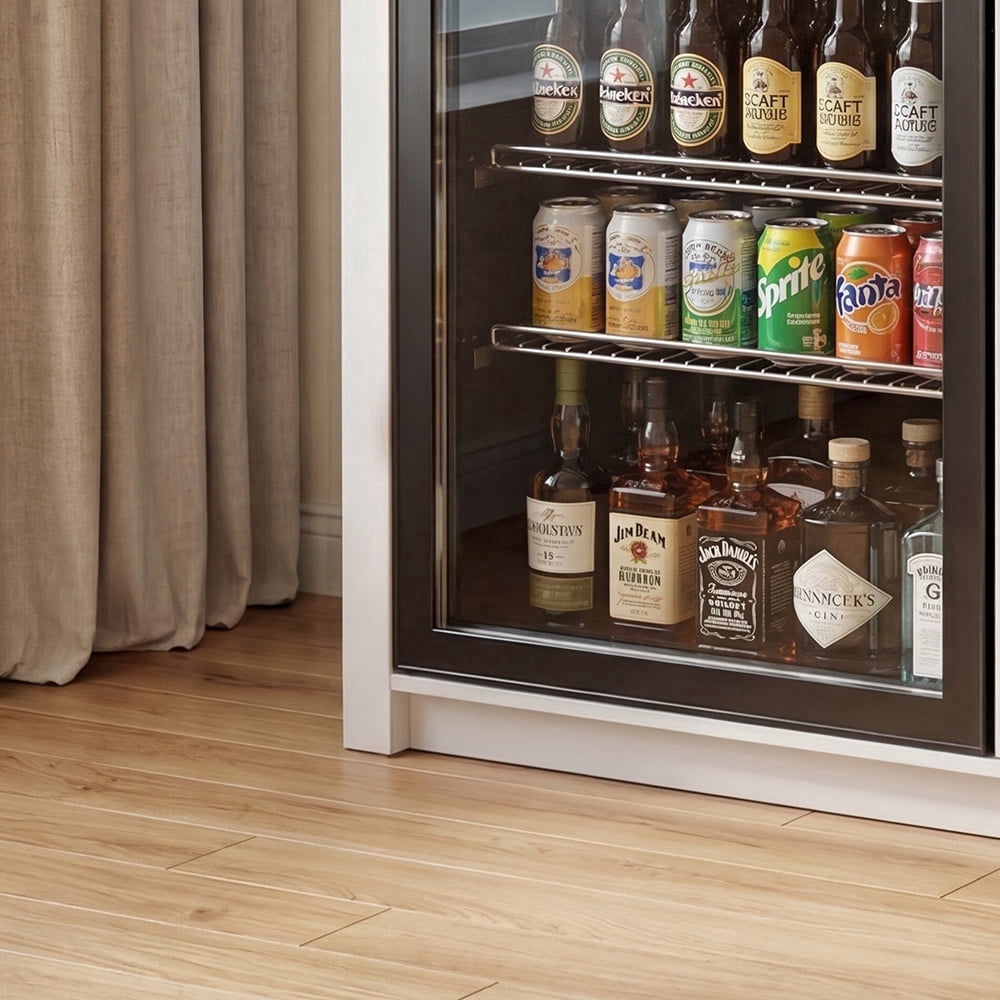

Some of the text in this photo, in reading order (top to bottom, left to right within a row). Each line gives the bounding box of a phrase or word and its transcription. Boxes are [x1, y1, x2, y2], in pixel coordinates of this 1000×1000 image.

[744, 92, 789, 108] SCAFT
[757, 252, 826, 320] Sprite
[613, 524, 634, 544] JIM
